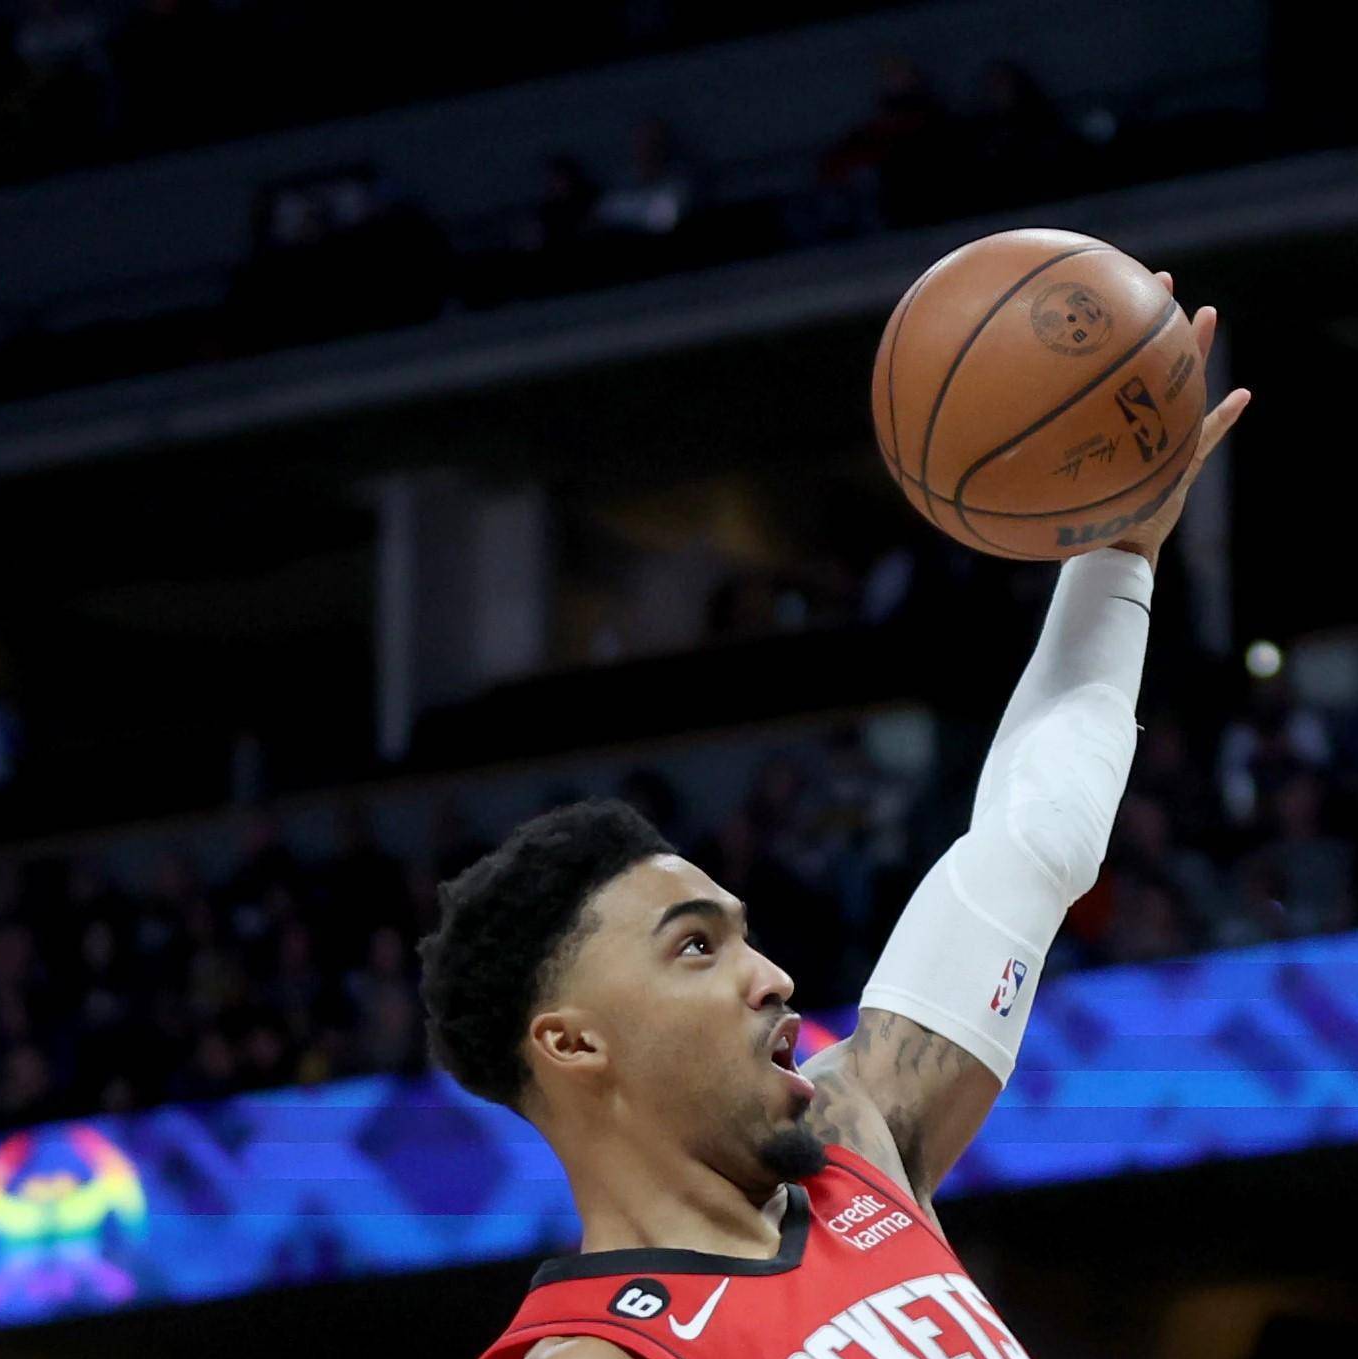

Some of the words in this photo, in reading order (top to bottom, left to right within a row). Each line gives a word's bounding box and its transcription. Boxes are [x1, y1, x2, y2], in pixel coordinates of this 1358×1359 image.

[827, 1194, 887, 1233] credit
[841, 1211, 913, 1251] karma
[615, 1287, 663, 1319] 6
